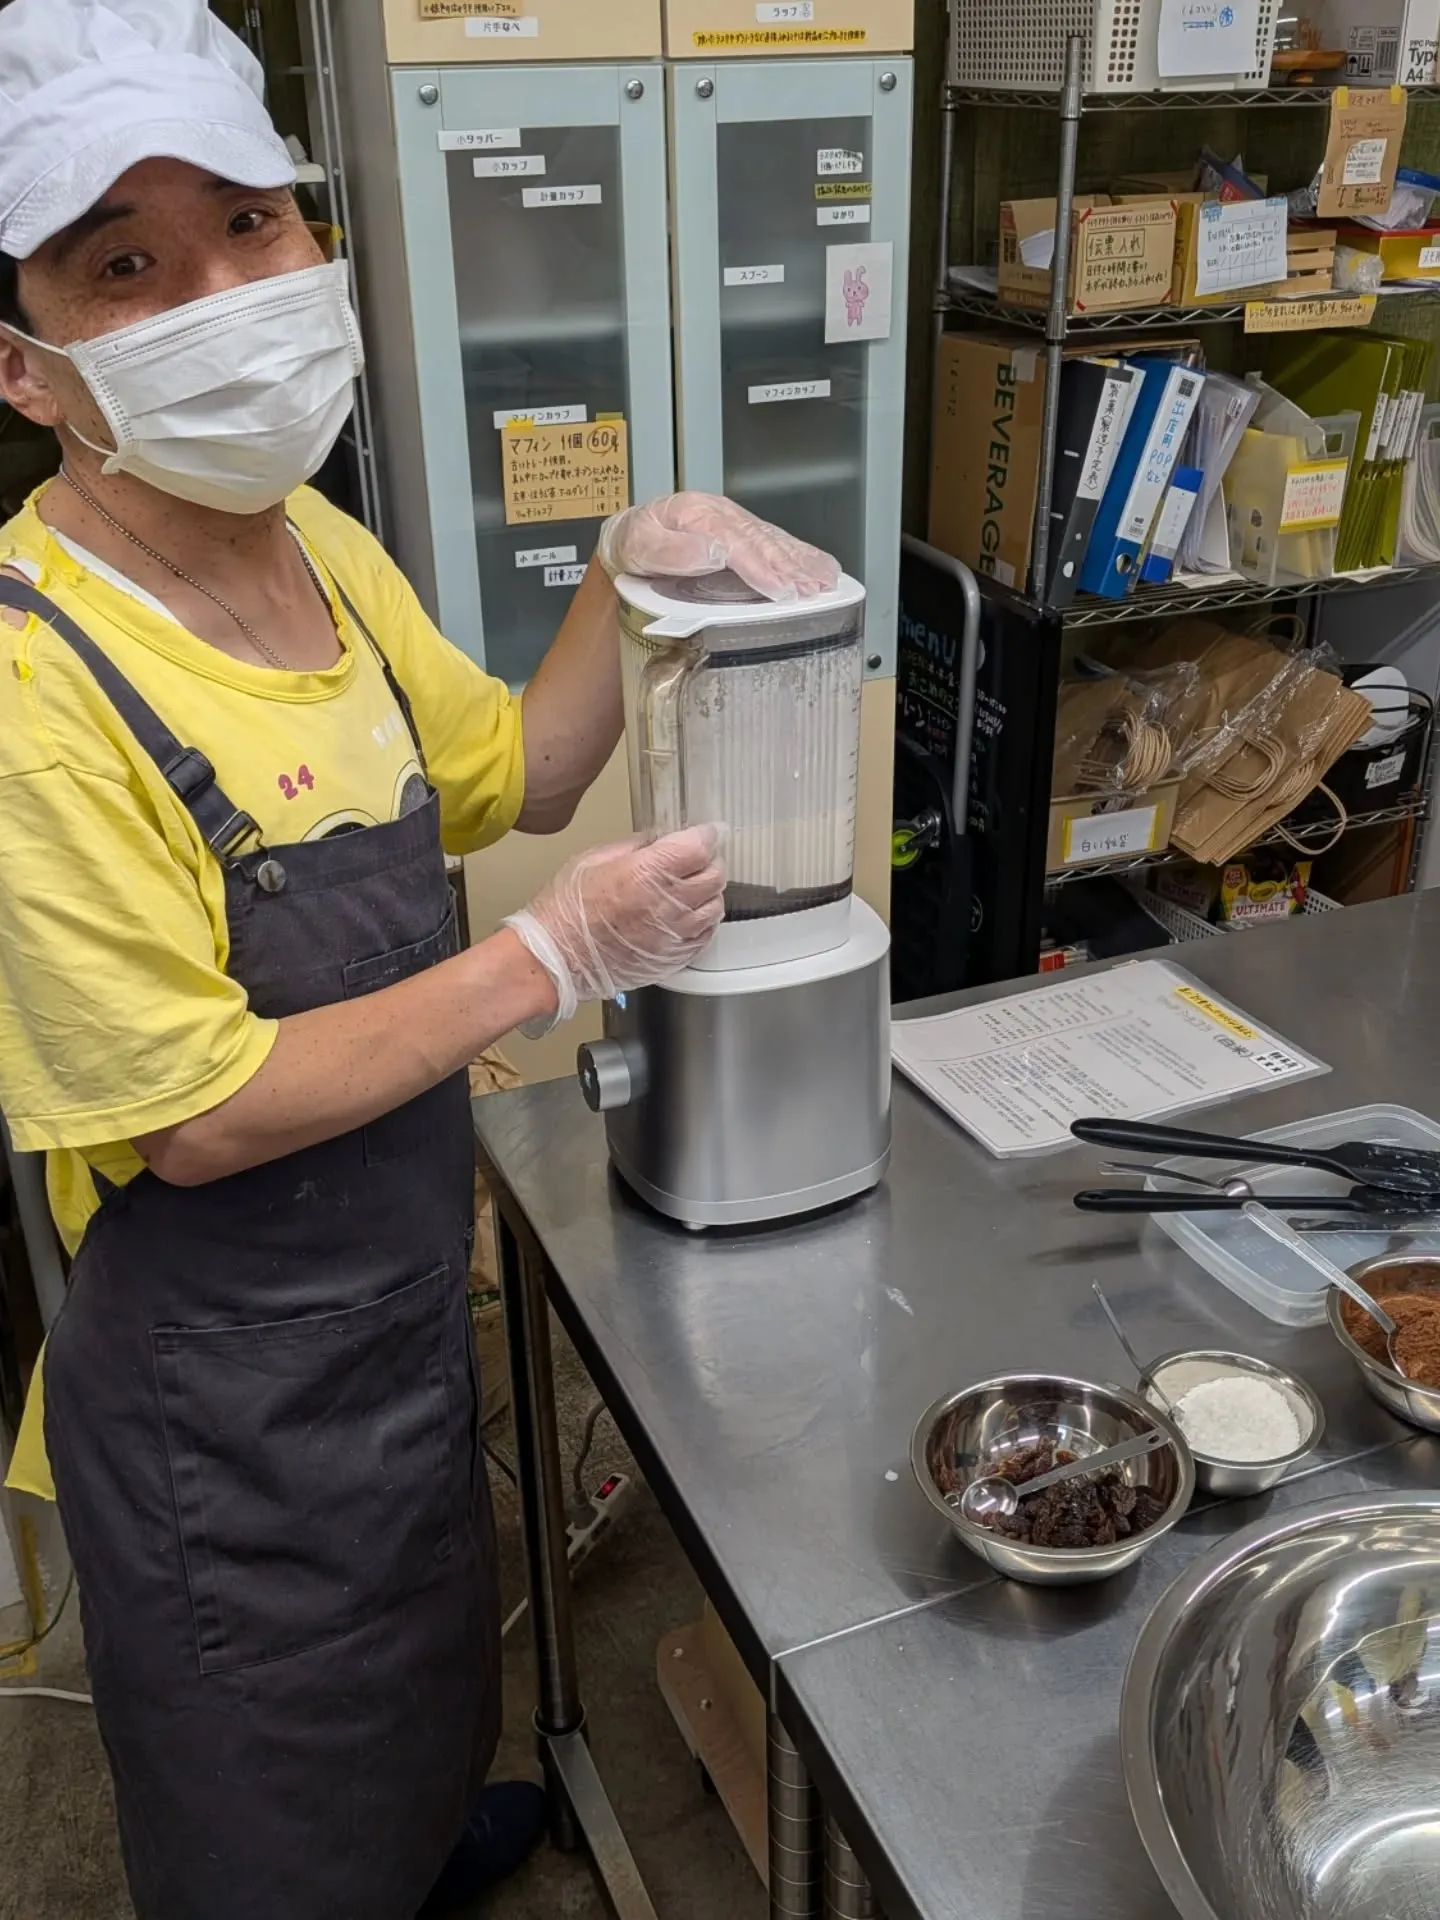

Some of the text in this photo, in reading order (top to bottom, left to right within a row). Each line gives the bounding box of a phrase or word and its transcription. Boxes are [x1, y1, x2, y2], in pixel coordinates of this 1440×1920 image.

[773, 7, 798, 17] ラップ
[483, 21, 520, 33] 片手なべ
[1406, 68, 1424, 82] A4
[457, 133, 503, 145] 小タッパー
[492, 160, 528, 173] 小カップ
[540, 189, 584, 202] 計量カップ
[832, 210, 854, 219] はかり
[741, 270, 768, 281] スプーン
[765, 385, 816, 398] マフィンカップ
[1161, 400, 1187, 449] 出店用
[509, 436, 552, 455] マフィン
[1150, 449, 1172, 469] POP
[979, 362, 1017, 573] BEVERAGE
[899, 613, 957, 667] menu
[278, 764, 315, 800] 24
[1235, 901, 1287, 917] ULTIMATE
